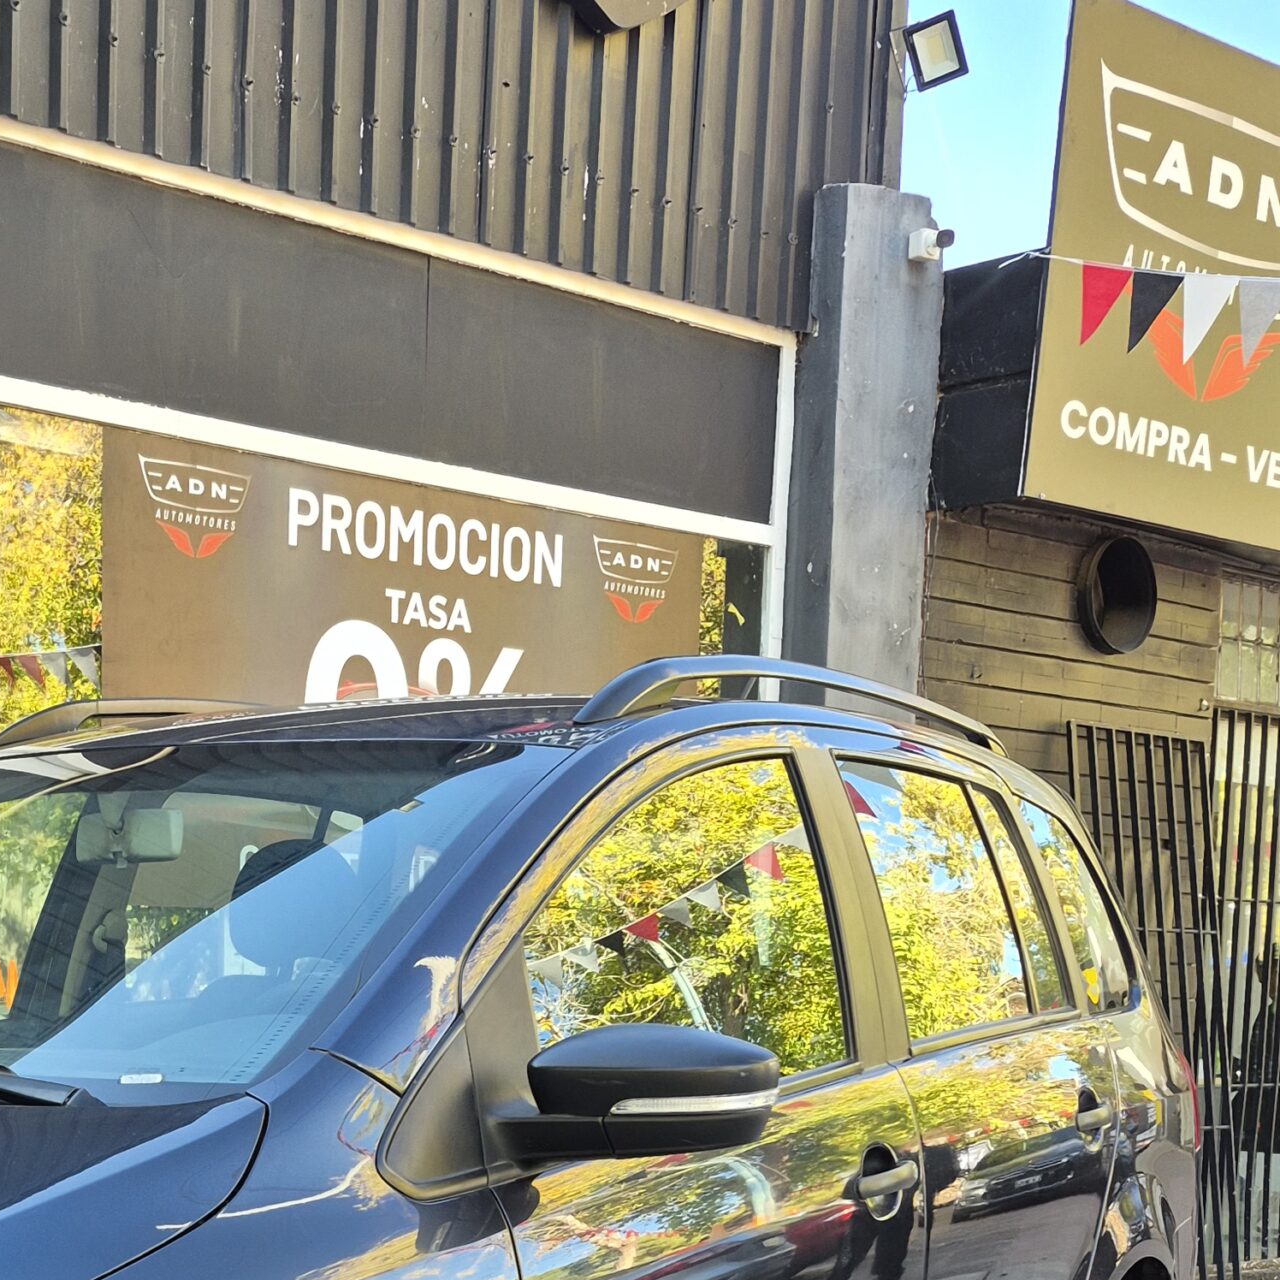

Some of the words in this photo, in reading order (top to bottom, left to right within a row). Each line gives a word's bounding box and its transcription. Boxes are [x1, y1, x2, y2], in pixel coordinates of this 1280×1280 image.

[1060, 399, 1212, 472] COMPRA
[165, 474, 227, 500] ADN
[155, 508, 236, 531] AUTOMOTORES
[288, 487, 564, 588] PROMOCION
[612, 551, 660, 572] ADN
[604, 581, 666, 599] AUTOMOTORES
[385, 588, 472, 633] TASA
